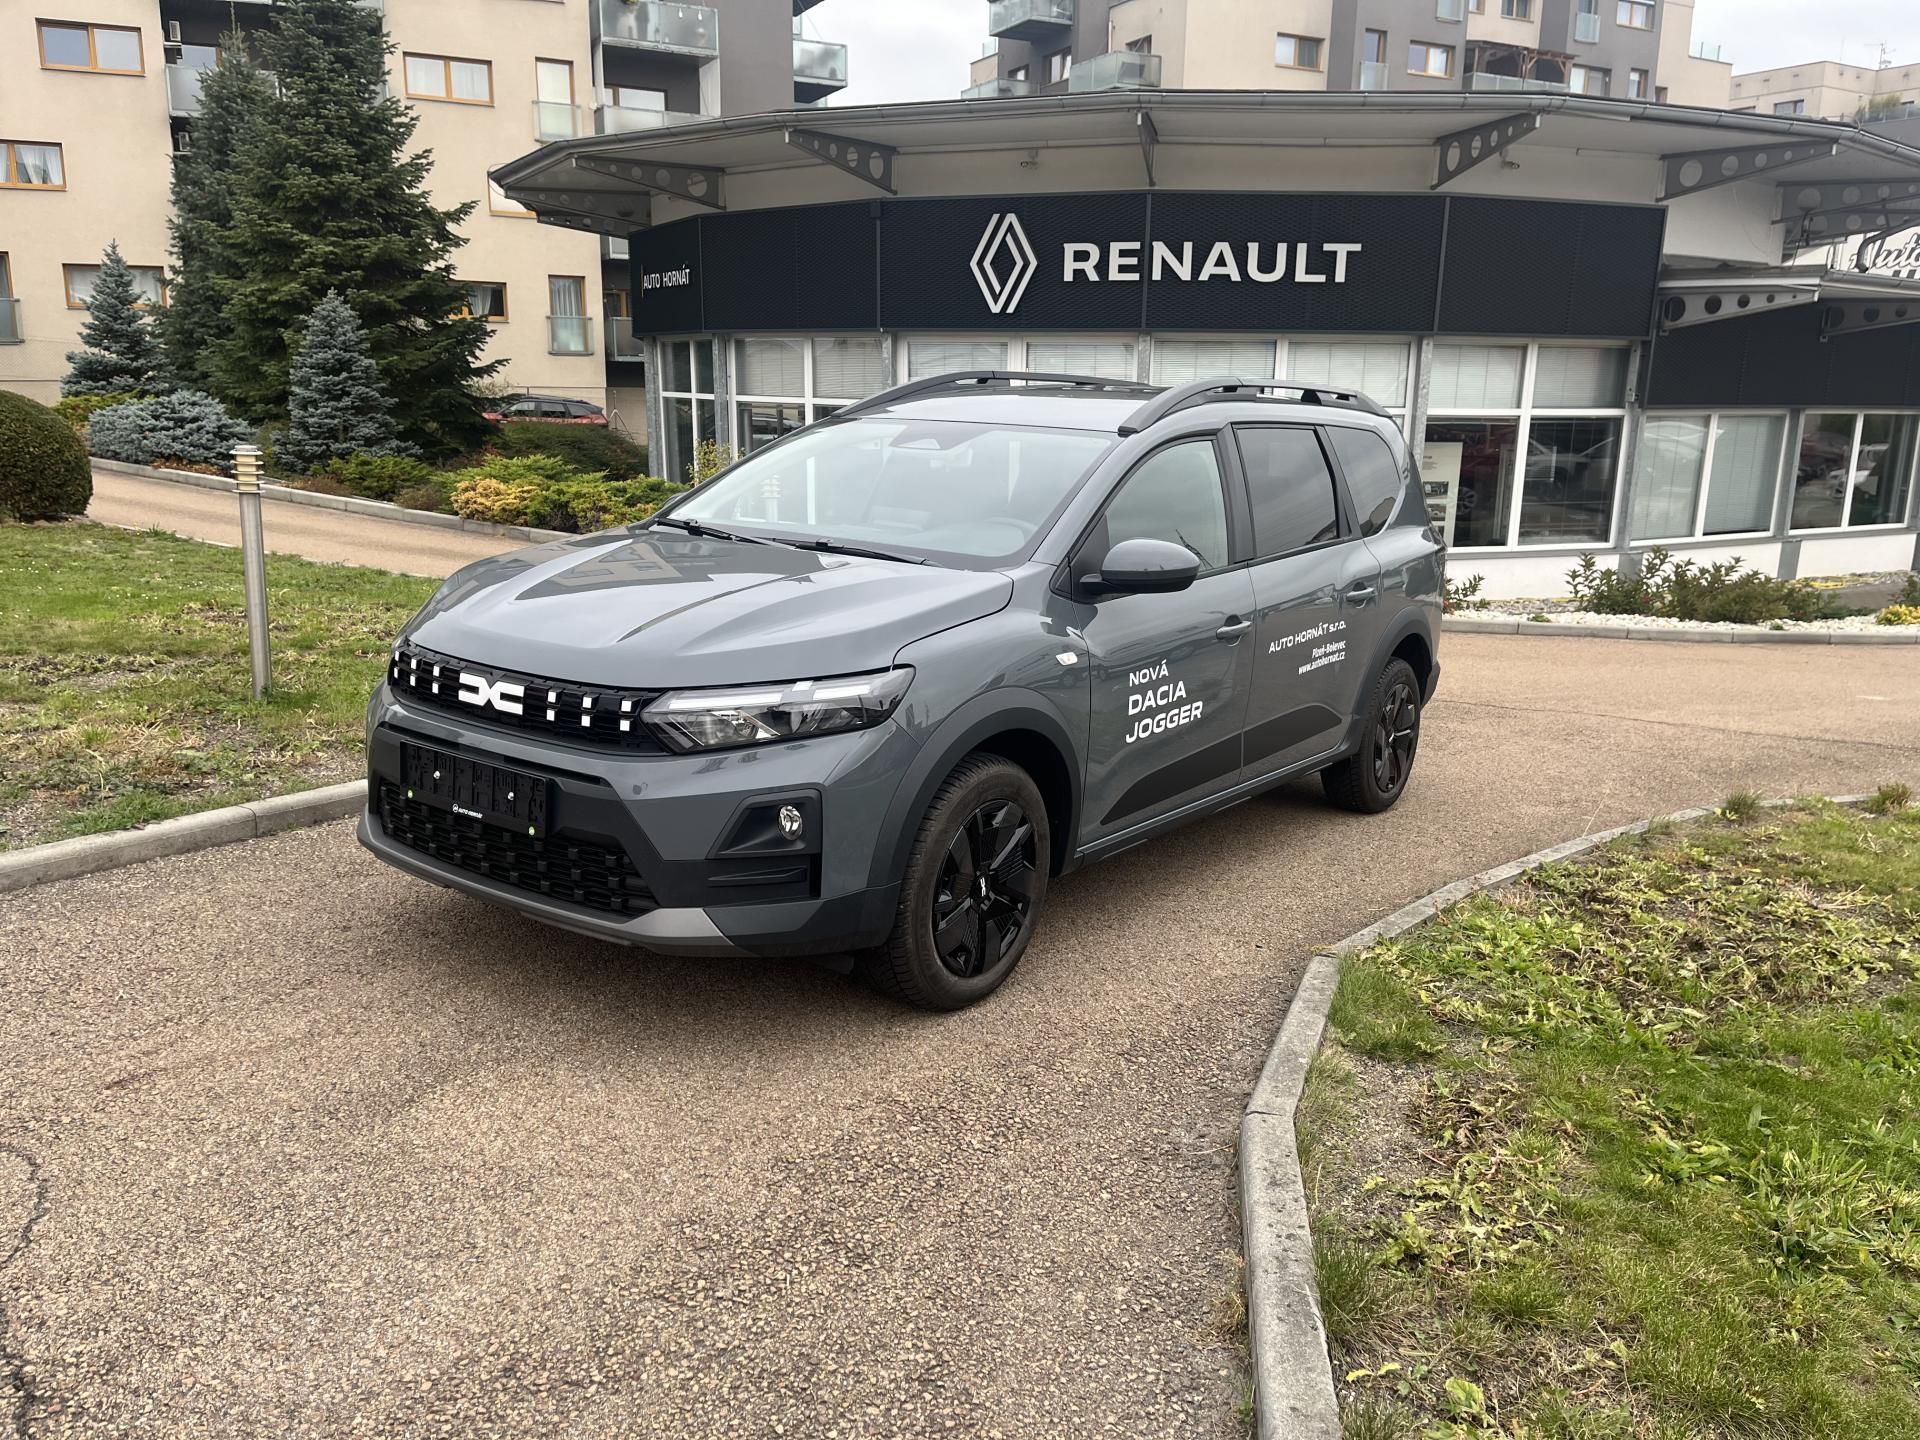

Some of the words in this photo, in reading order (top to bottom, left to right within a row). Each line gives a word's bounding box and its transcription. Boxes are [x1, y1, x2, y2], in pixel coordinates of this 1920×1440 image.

[643, 273, 661, 290] AUTO
[662, 263, 690, 288] HORNÁT
[1063, 241, 1362, 283] RENAULT
[1268, 635, 1294, 654] AUTO
[1294, 622, 1329, 645] HORNÁT
[1129, 659, 1169, 687] NOVÁ
[1128, 680, 1187, 716] DACIA
[1125, 701, 1203, 744] JOGGER
